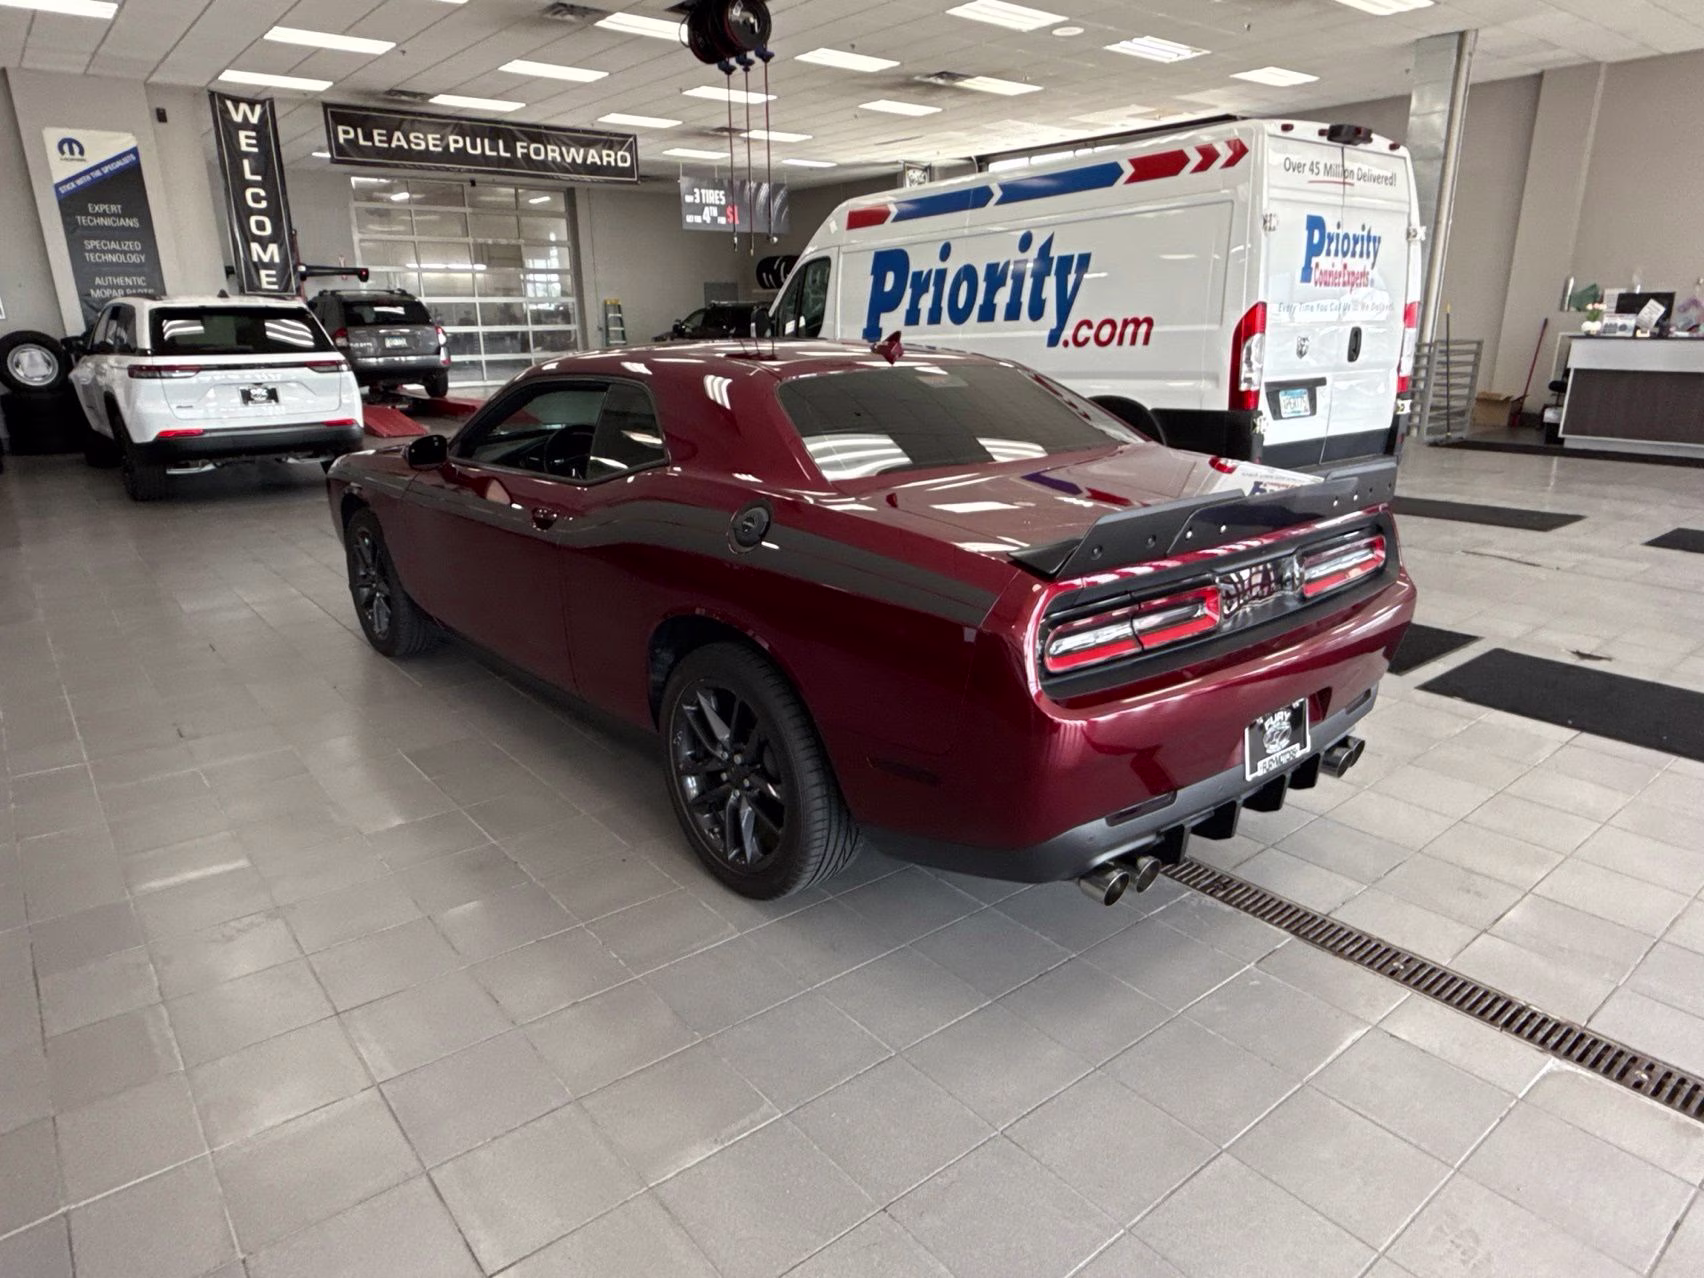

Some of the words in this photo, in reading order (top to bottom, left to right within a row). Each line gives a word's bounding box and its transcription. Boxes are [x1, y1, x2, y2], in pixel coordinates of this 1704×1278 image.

[337, 125, 442, 152] PLEASE
[448, 135, 511, 157] PULL
[516, 142, 631, 167] FORWARD
[1283, 157, 1306, 174] Over
[1308, 161, 1320, 176] 45
[1323, 163, 1355, 179] Million
[1356, 167, 1397, 187] Delivered!
[225, 99, 281, 290] WELCOME
[693, 188, 701, 204] 3
[701, 189, 726, 205] TIRES
[88, 203, 122, 214] EXPERT
[75, 216, 140, 228] TECHNICIANS
[83, 240, 142, 251] SPECIALIZED
[1300, 214, 1381, 284] Priority
[84, 252, 146, 263] TECHNOLOGY
[95, 276, 147, 286] AUTHENTIC
[90, 289, 124, 298] MOPAR
[862, 230, 1092, 348] Priority
